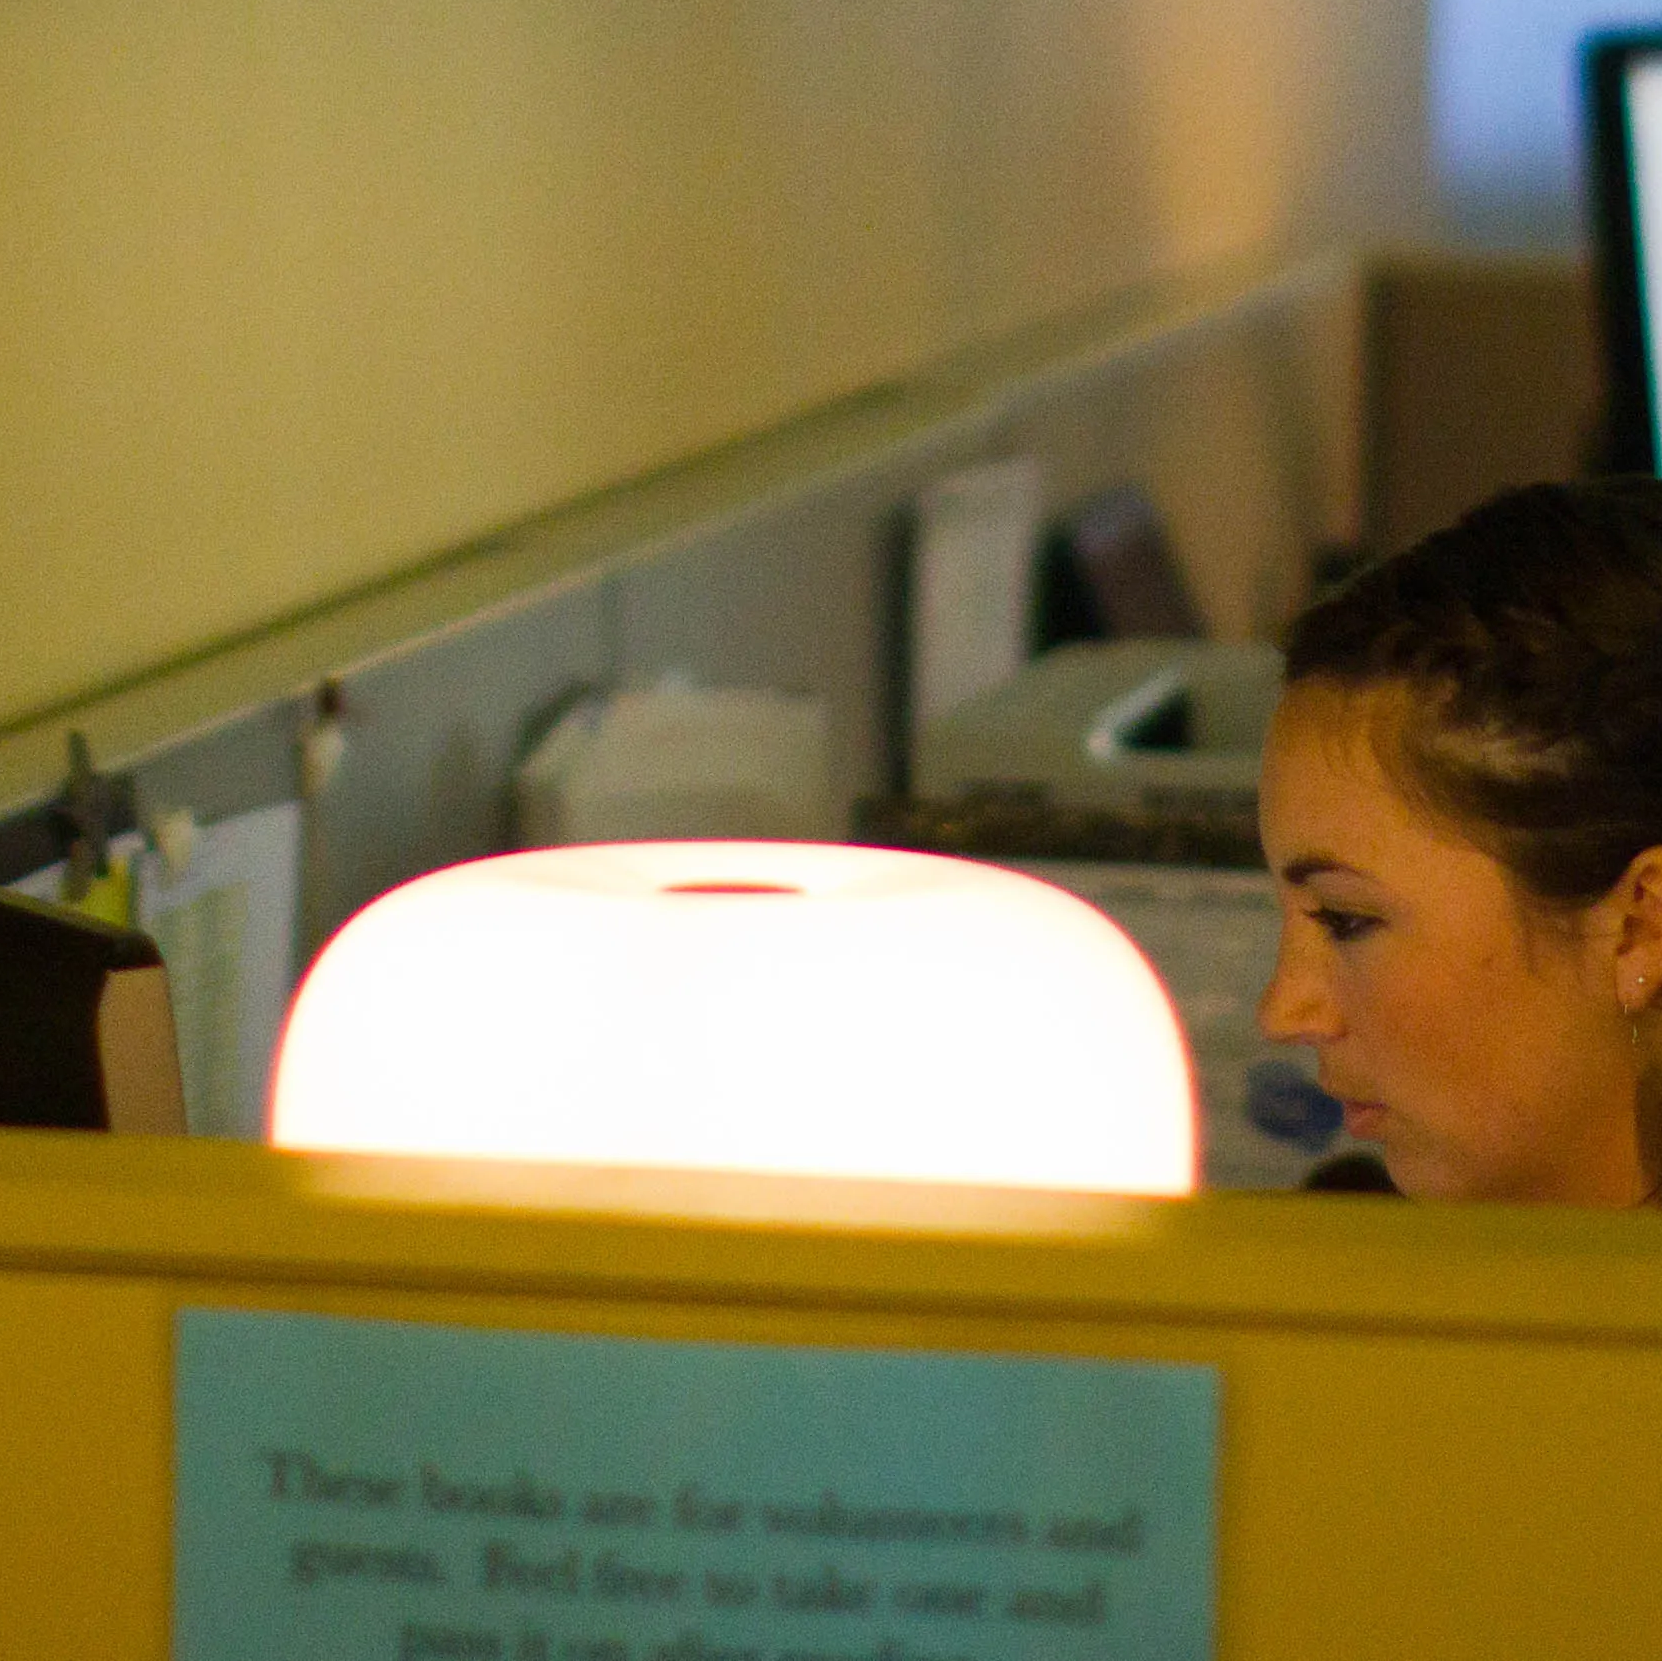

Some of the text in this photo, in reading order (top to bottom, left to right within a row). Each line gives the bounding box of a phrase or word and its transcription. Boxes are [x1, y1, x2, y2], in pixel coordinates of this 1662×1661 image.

[257, 1448, 406, 1506] These
[418, 1465, 563, 1519] books
[578, 1490, 655, 1528] are
[672, 1482, 741, 1533] for
[1045, 1504, 1145, 1553] and
[480, 1541, 579, 1593] Feel
[594, 1550, 685, 1598] free
[705, 1567, 759, 1606] to
[772, 1567, 870, 1614] take
[1002, 1576, 1106, 1625] and
